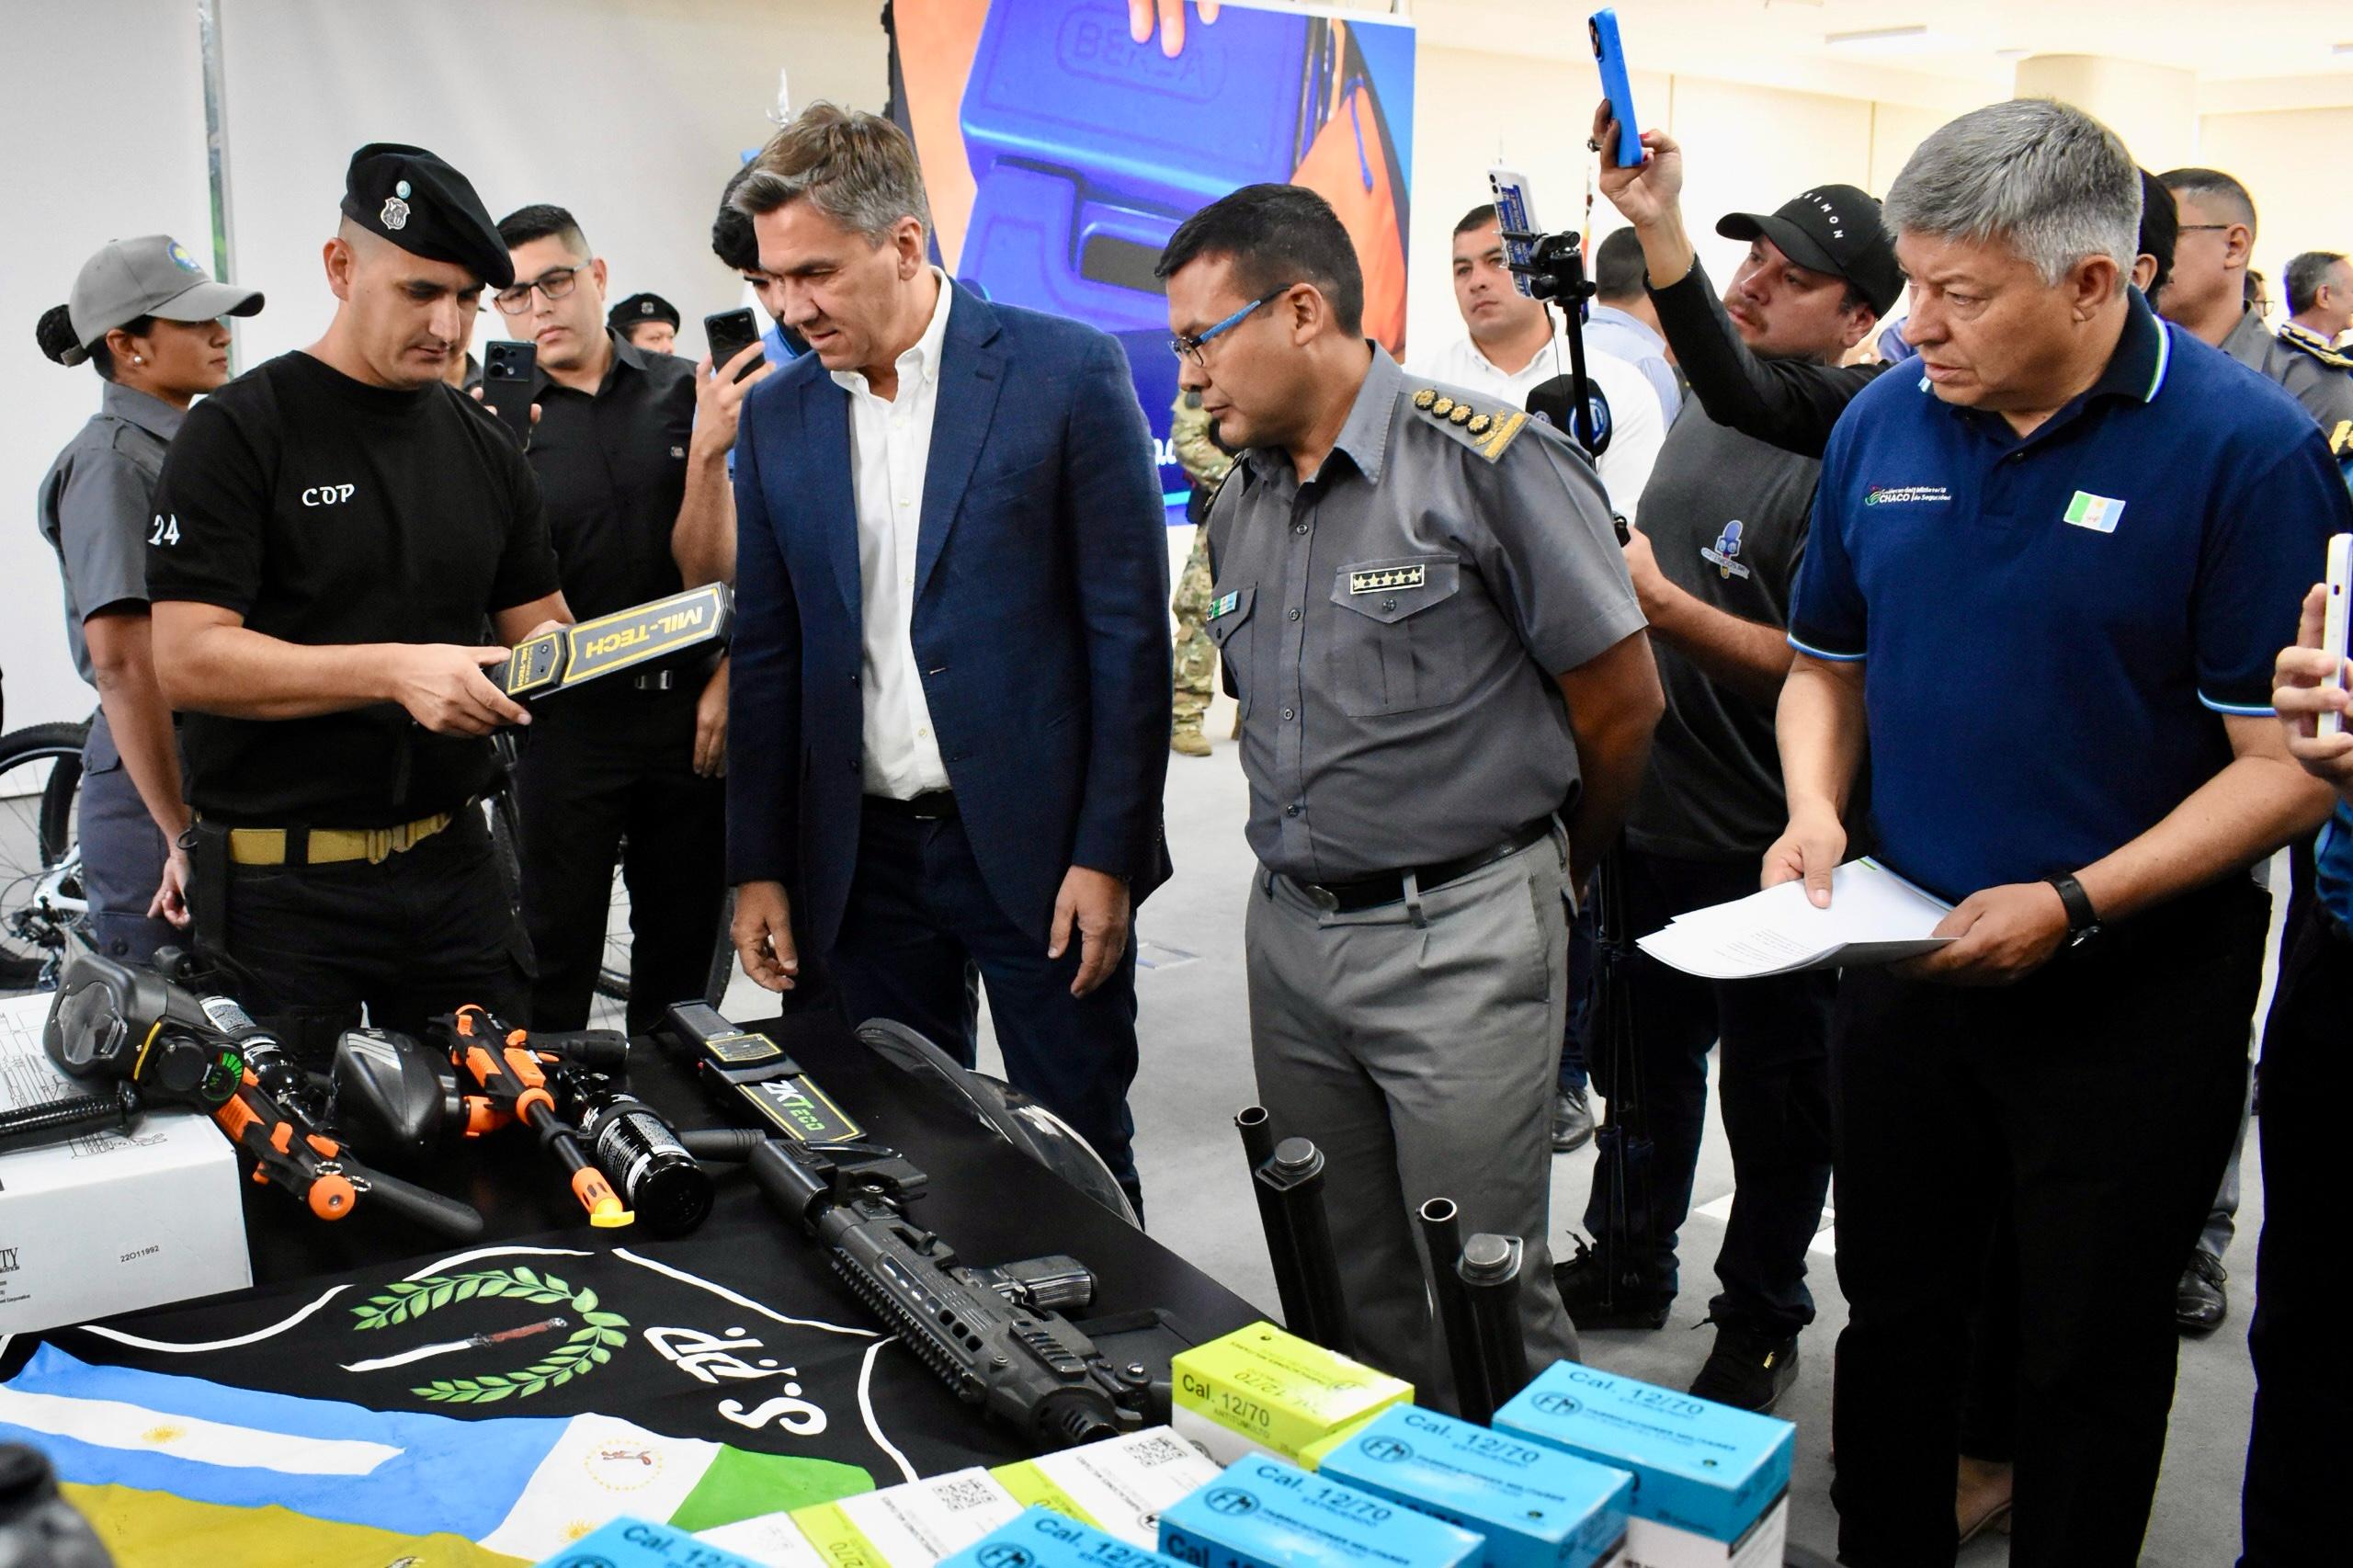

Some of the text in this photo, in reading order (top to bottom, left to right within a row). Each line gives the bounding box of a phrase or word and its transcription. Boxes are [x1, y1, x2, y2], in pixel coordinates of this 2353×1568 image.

[1793, 192, 1844, 238] SIMON
[301, 483, 355, 506] COP
[1879, 494, 1910, 503] CHACO
[148, 514, 180, 545] 24
[1182, 1374, 1215, 1403] Cal.
[1222, 1392, 1270, 1427] 12/70
[1569, 1371, 1616, 1392] Cal.
[1631, 1389, 1704, 1414] 12/70
[1404, 1414, 1451, 1438] Cal.
[1467, 1433, 1540, 1463] 12/70
[1256, 1465, 1303, 1493] Cal.
[1318, 1487, 1392, 1521] 12/70
[622, 1526, 669, 1556] Cal.
[1035, 1518, 1083, 1548] Cal.
